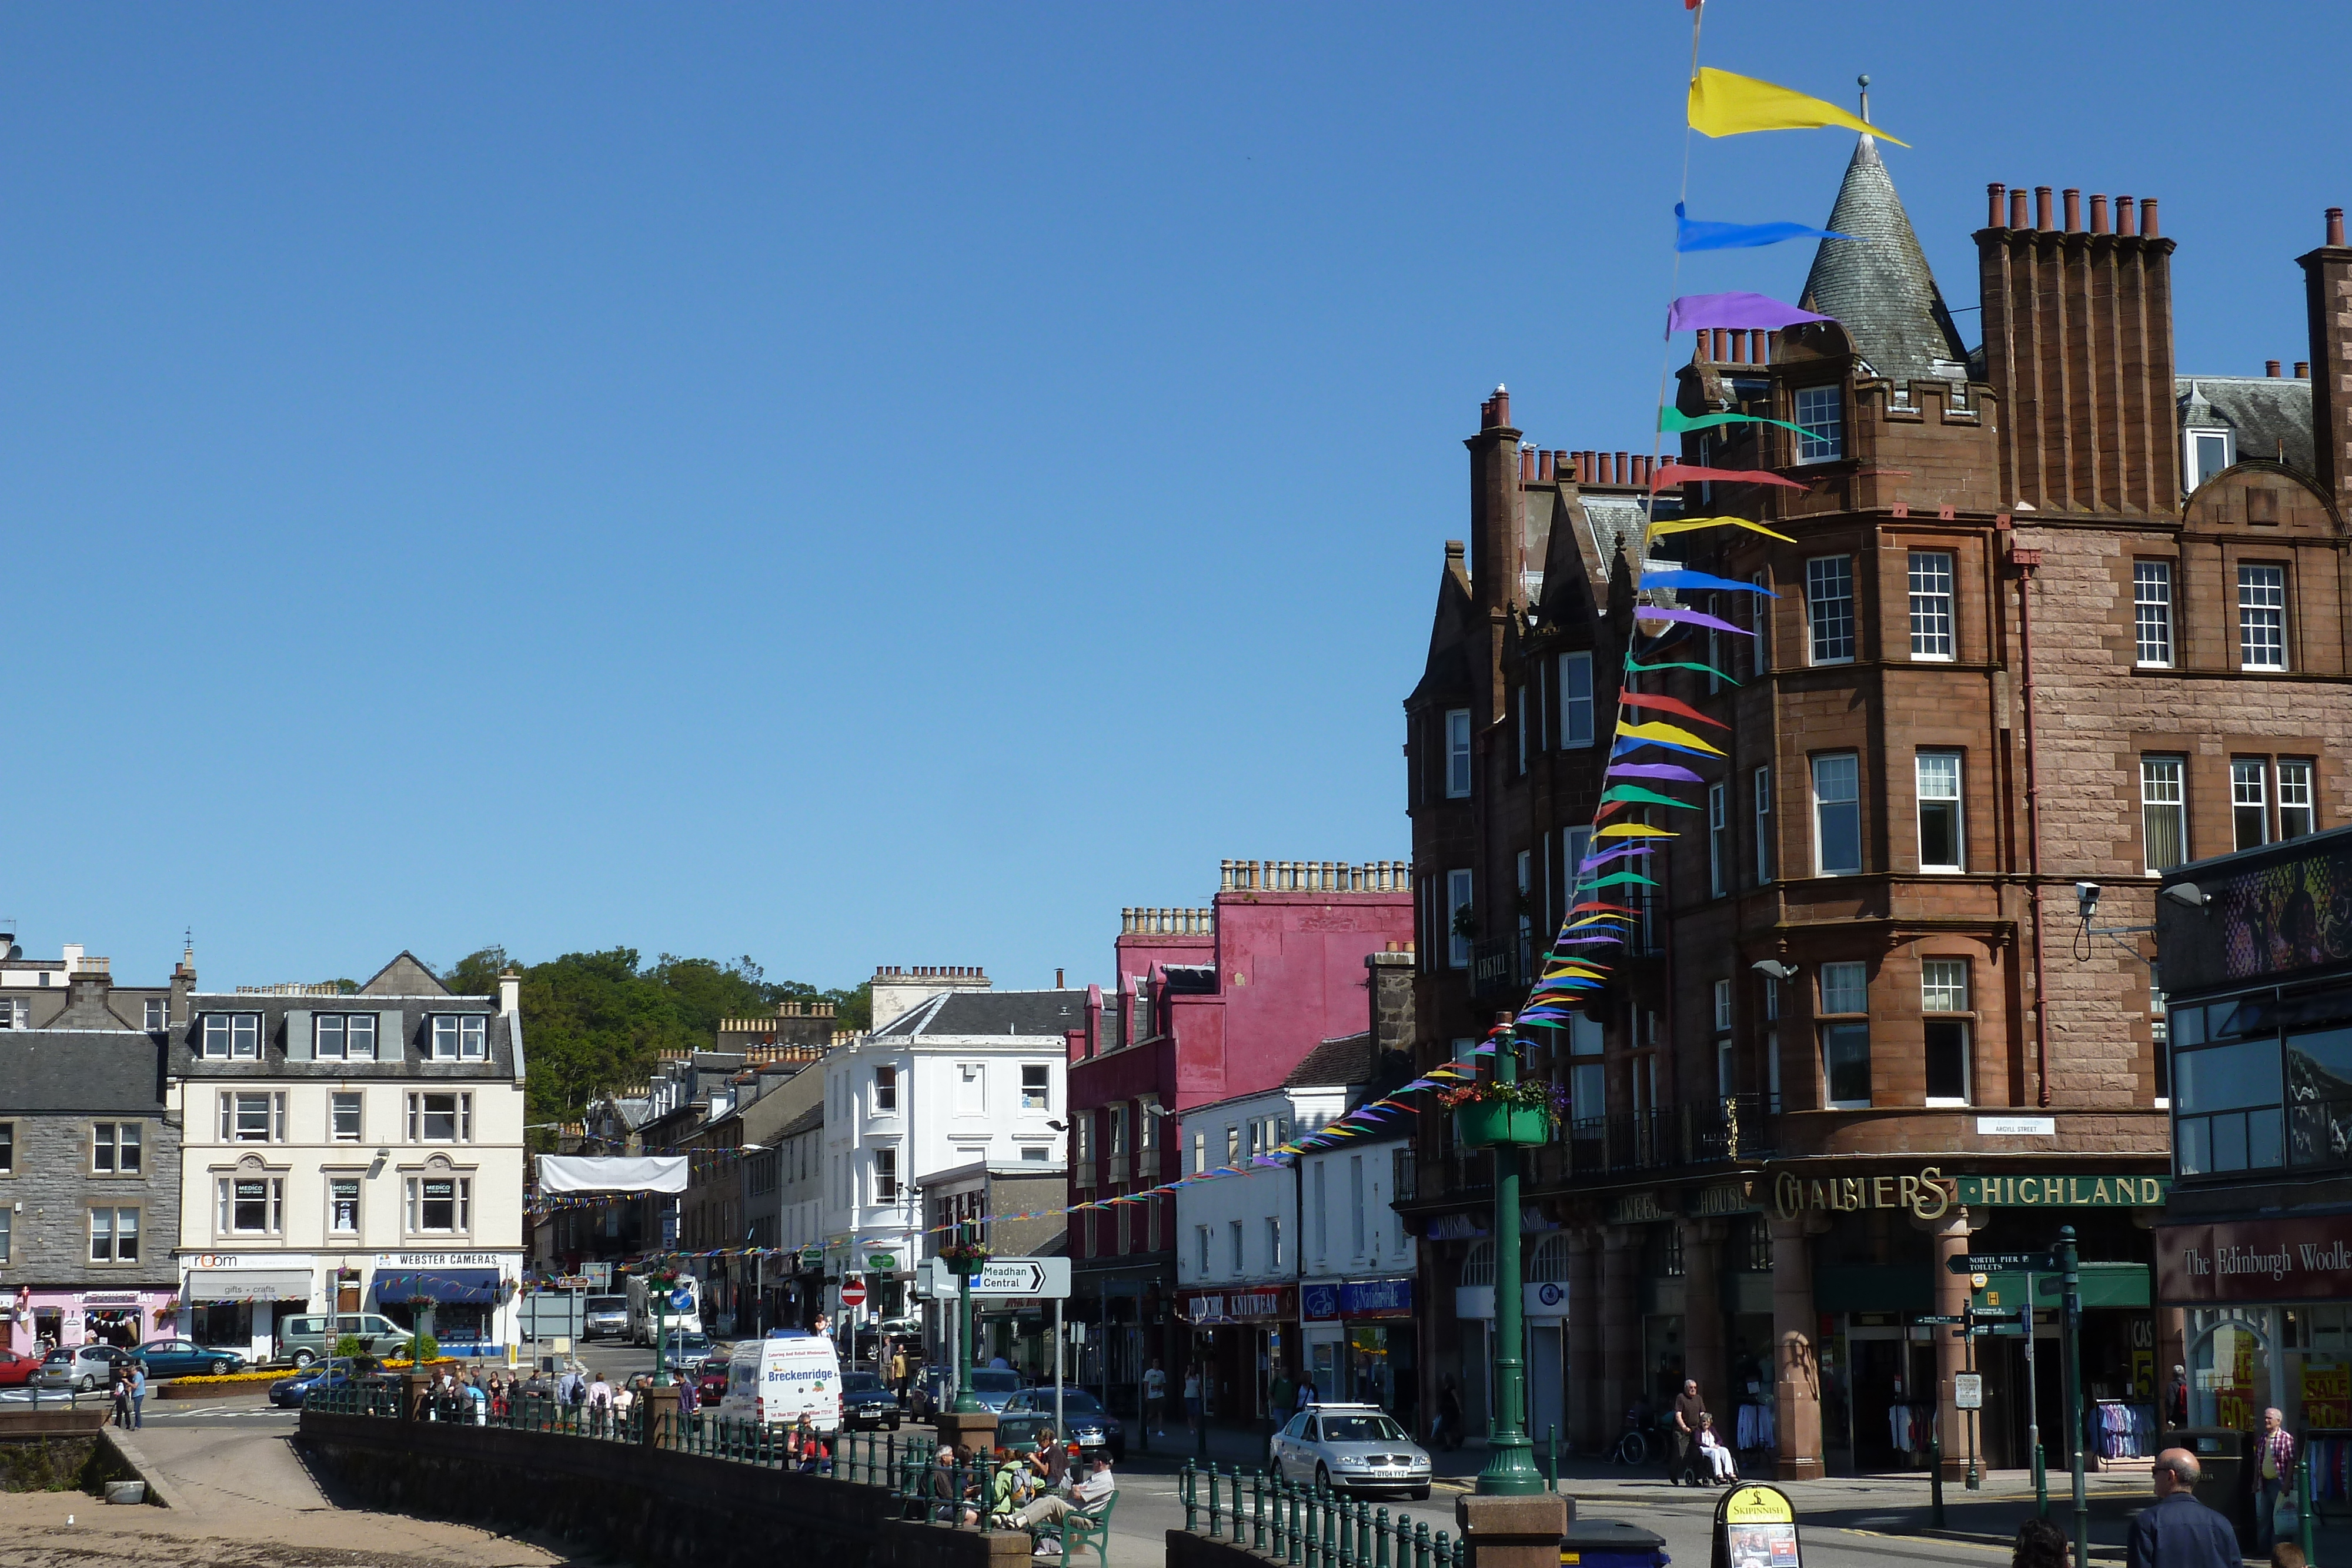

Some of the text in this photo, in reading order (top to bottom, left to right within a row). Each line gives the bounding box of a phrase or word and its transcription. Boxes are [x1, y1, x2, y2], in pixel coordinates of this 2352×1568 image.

[1700, 1188, 1748, 1214] HOUSE
[1775, 1167, 2160, 1220] CHALMERS HIGHLAND
[400, 1255, 445, 1265] WEBSTER
[450, 1255, 497, 1265] CAMERAS
[2184, 1240, 2352, 1281] The Edinburgh Woolle
[984, 1267, 1027, 1276] Meadhan
[225, 1286, 242, 1295] gifts
[984, 1278, 1020, 1287] Central
[1231, 1293, 1278, 1316] KNITWEAR
[1359, 1285, 1399, 1309] Nationwide
[769, 1369, 833, 1382] Breckenridge
[2306, 1379, 2348, 1399] SALE
